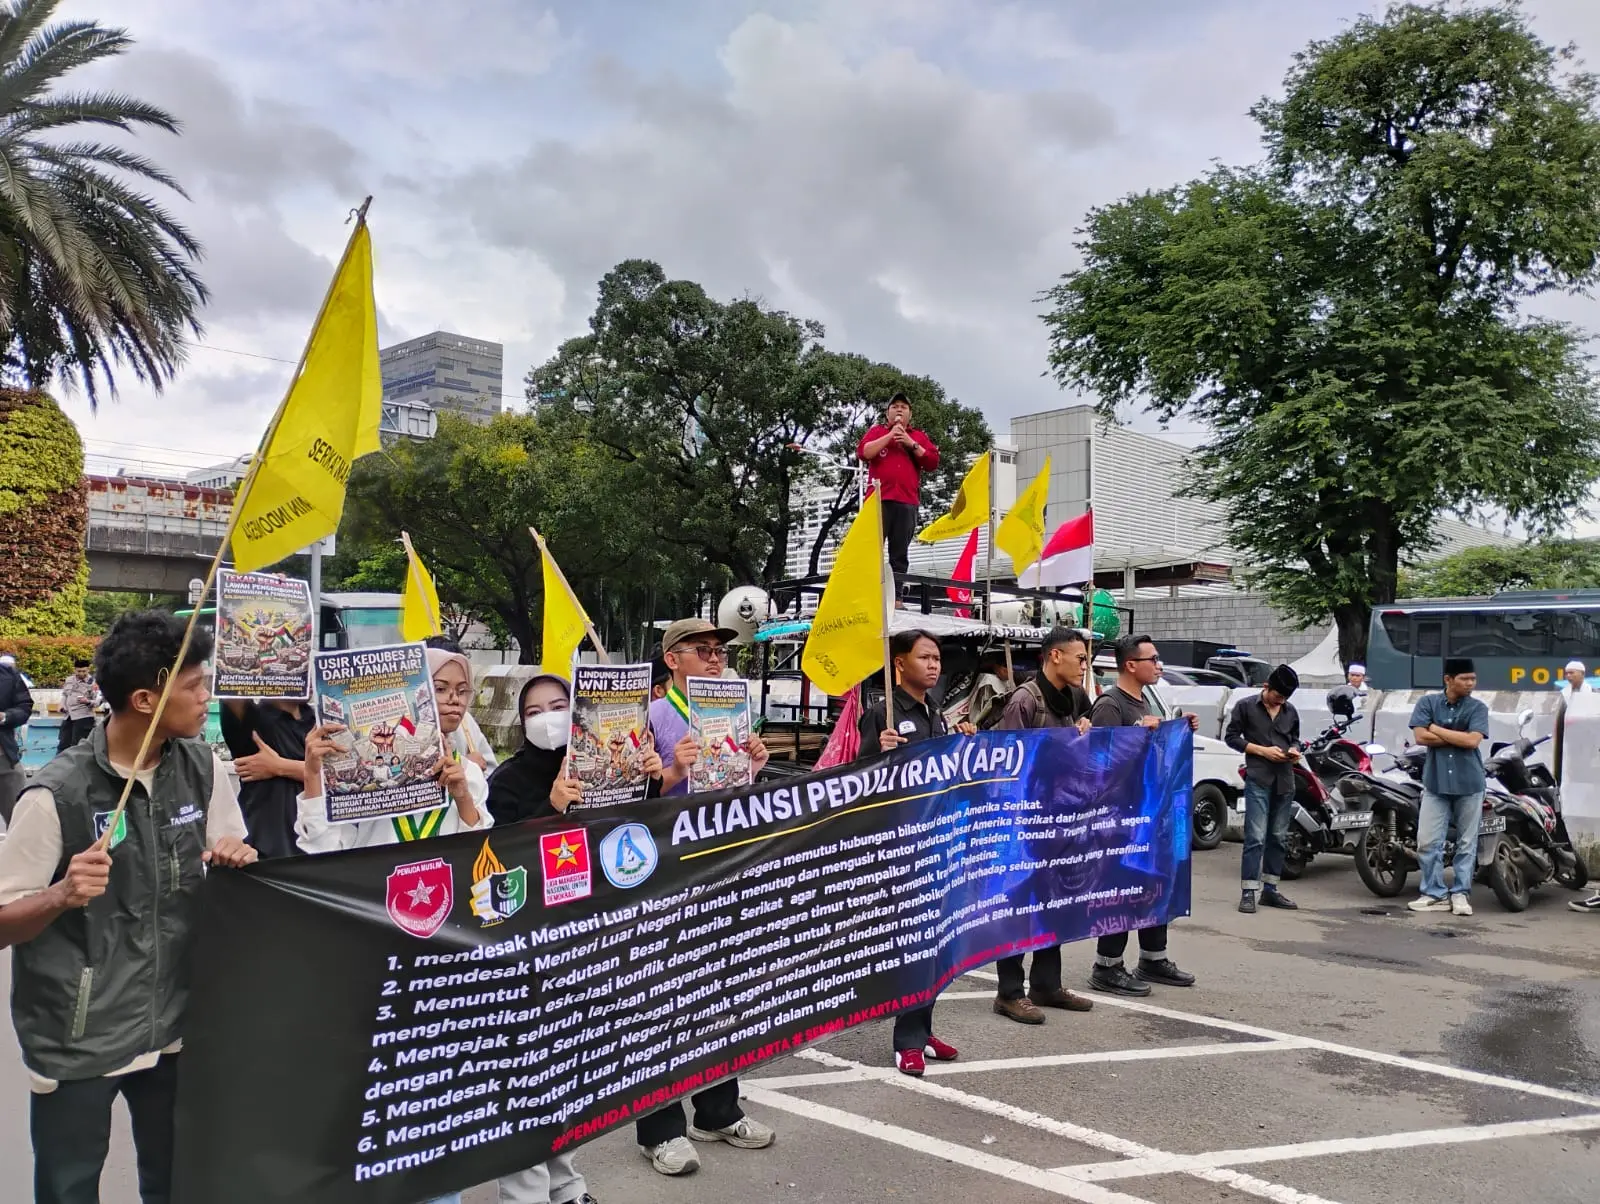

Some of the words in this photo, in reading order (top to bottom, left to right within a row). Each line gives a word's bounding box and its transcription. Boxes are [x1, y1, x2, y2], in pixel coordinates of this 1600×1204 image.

[318, 656, 350, 670] USIR
[352, 650, 405, 666] KEDUBES
[408, 647, 422, 658] AS
[322, 668, 354, 680] DARI
[357, 661, 398, 676] TANAH
[400, 658, 422, 671] AIR!
[578, 670, 619, 679] LINDUNGI
[620, 671, 627, 679] &
[579, 679, 608, 690] WNI
[611, 678, 648, 690] SEGERA!
[331, 799, 363, 808] PERKUAT
[364, 794, 408, 804] KEDAULATAN
[331, 805, 381, 816] PERTAHANKAN
[382, 799, 416, 808] MARTABAT
[373, 788, 406, 798] DIPLOMASI
[671, 789, 803, 845] ALIANSI
[807, 764, 895, 817] PEDULI
[899, 751, 962, 791] IRAN
[961, 740, 1025, 781] (API)
[387, 955, 403, 971] 1.
[414, 934, 528, 968] mendesak
[530, 913, 601, 948] Menteri
[602, 904, 640, 927] Luar
[641, 886, 690, 915] Negeri
[742, 859, 781, 879] segera
[783, 842, 838, 868] memutus
[839, 829, 897, 852] hubungan
[963, 801, 1001, 818] Amerika
[1002, 799, 1044, 812] Serikat.
[396, 865, 421, 876] PEMUDA
[546, 884, 571, 896] NASIONAL
[546, 890, 576, 903] DEMOKRASI
[559, 871, 588, 885] MAHASISWA
[375, 1004, 397, 1021] 3.
[413, 984, 530, 1014] Menuntut
[541, 955, 620, 993] Kedutaan
[629, 937, 670, 962] Besar
[676, 915, 733, 944] Amerika
[740, 897, 784, 921] Serikat
[790, 888, 818, 906] agar
[824, 862, 911, 897] menyampaikan
[914, 852, 941, 872] pesan
[970, 833, 1011, 848] Presiden
[1016, 828, 1057, 842] Donald
[1091, 818, 1117, 831] untuk
[1121, 815, 1151, 828] segera
[381, 980, 403, 997] 2.
[408, 961, 531, 992] mendesak
[534, 937, 599, 973] Menteri
[600, 927, 635, 950] Luar
[636, 908, 682, 937] Negeri
[683, 904, 698, 920] RI
[699, 888, 739, 914] untuk
[741, 874, 796, 901] menutup
[797, 866, 820, 883] dan
[821, 851, 876, 877] mengusir
[876, 843, 916, 862] Kantor
[971, 815, 1013, 833] Amerika
[1013, 814, 1054, 826] Serikat
[1055, 813, 1076, 824] dari
[368, 1056, 389, 1074] 4.
[395, 1032, 511, 1068] Mengajak
[515, 1009, 583, 1046] seluruh
[588, 990, 647, 1019] lapisan
[649, 957, 727, 1000] masyarakat
[729, 934, 792, 967] Indonesia
[793, 921, 833, 945] untuk
[834, 902, 900, 932] melakukan
[951, 872, 968, 889] total
[967, 863, 1007, 882] terhadap
[1008, 857, 1048, 872] seluruh
[1049, 853, 1084, 868] produk
[1083, 848, 1104, 863] yang
[372, 1004, 542, 1048] menghentikan
[544, 977, 614, 1013] eskalasi
[614, 957, 665, 991] konflik
[666, 940, 718, 970] dengan
[719, 910, 809, 950] negara-negara
[810, 899, 846, 919] timur
[846, 887, 889, 909] tengah,
[891, 871, 935, 896] termasuk
[960, 849, 1000, 868] Palestina.
[357, 1135, 378, 1153] 6.
[385, 1100, 501, 1147] Mendesak
[506, 1074, 578, 1112] Menteri
[583, 1060, 620, 1085] Luar
[623, 1036, 673, 1068] Negeri
[675, 1028, 692, 1046] RI
[695, 1013, 738, 1037] untuk
[740, 986, 809, 1022] melakukan
[812, 961, 872, 994] diplomasi
[874, 955, 901, 974] atas
[903, 944, 938, 964] barang
[956, 912, 990, 935] termasuk
[991, 906, 1014, 922] BBM
[1015, 902, 1045, 916] untuk
[1074, 886, 1118, 904] melewati
[1119, 885, 1144, 897] selat
[361, 1109, 382, 1127] 5.
[385, 1078, 503, 1121] Mendesak
[506, 1055, 578, 1090] Menteri
[580, 1038, 618, 1061] Luar
[619, 1018, 672, 1050] Negeri
[672, 1012, 691, 1029] RI
[692, 998, 732, 1023] untuk
[733, 980, 774, 1006] segera
[774, 954, 842, 988] melakukan
[843, 936, 895, 964] evakuasi
[895, 930, 923, 950] WNI
[923, 925, 936, 942] di
[364, 1066, 454, 1102] dengan
[457, 1045, 550, 1078] Amerika
[551, 1021, 612, 1055] Serikat
[613, 999, 675, 1031] sebagai
[676, 980, 723, 1010] bentuk
[724, 962, 768, 989] sanksi
[768, 943, 823, 973] ekonomi
[822, 935, 847, 952] atas
[847, 920, 899, 943] tindakan
[900, 907, 942, 928] mereka
[355, 1143, 448, 1183] hormuz
[450, 1119, 514, 1152] untuk
[518, 1091, 595, 1132] menjaga
[596, 1060, 668, 1101] stabilitas
[669, 1034, 728, 1073] pasokan
[729, 1015, 772, 1043] energi
[774, 1002, 815, 1027] dalam
[815, 986, 859, 1012] negeri.
[550, 1103, 631, 1153] #PEMUDA
[632, 1071, 704, 1115] MUSLIMIN
[704, 1061, 730, 1084] DKI
[730, 1037, 791, 1072] JAKARTA
[846, 998, 901, 1027] JAKARTA
[901, 988, 933, 1009] RAYA
